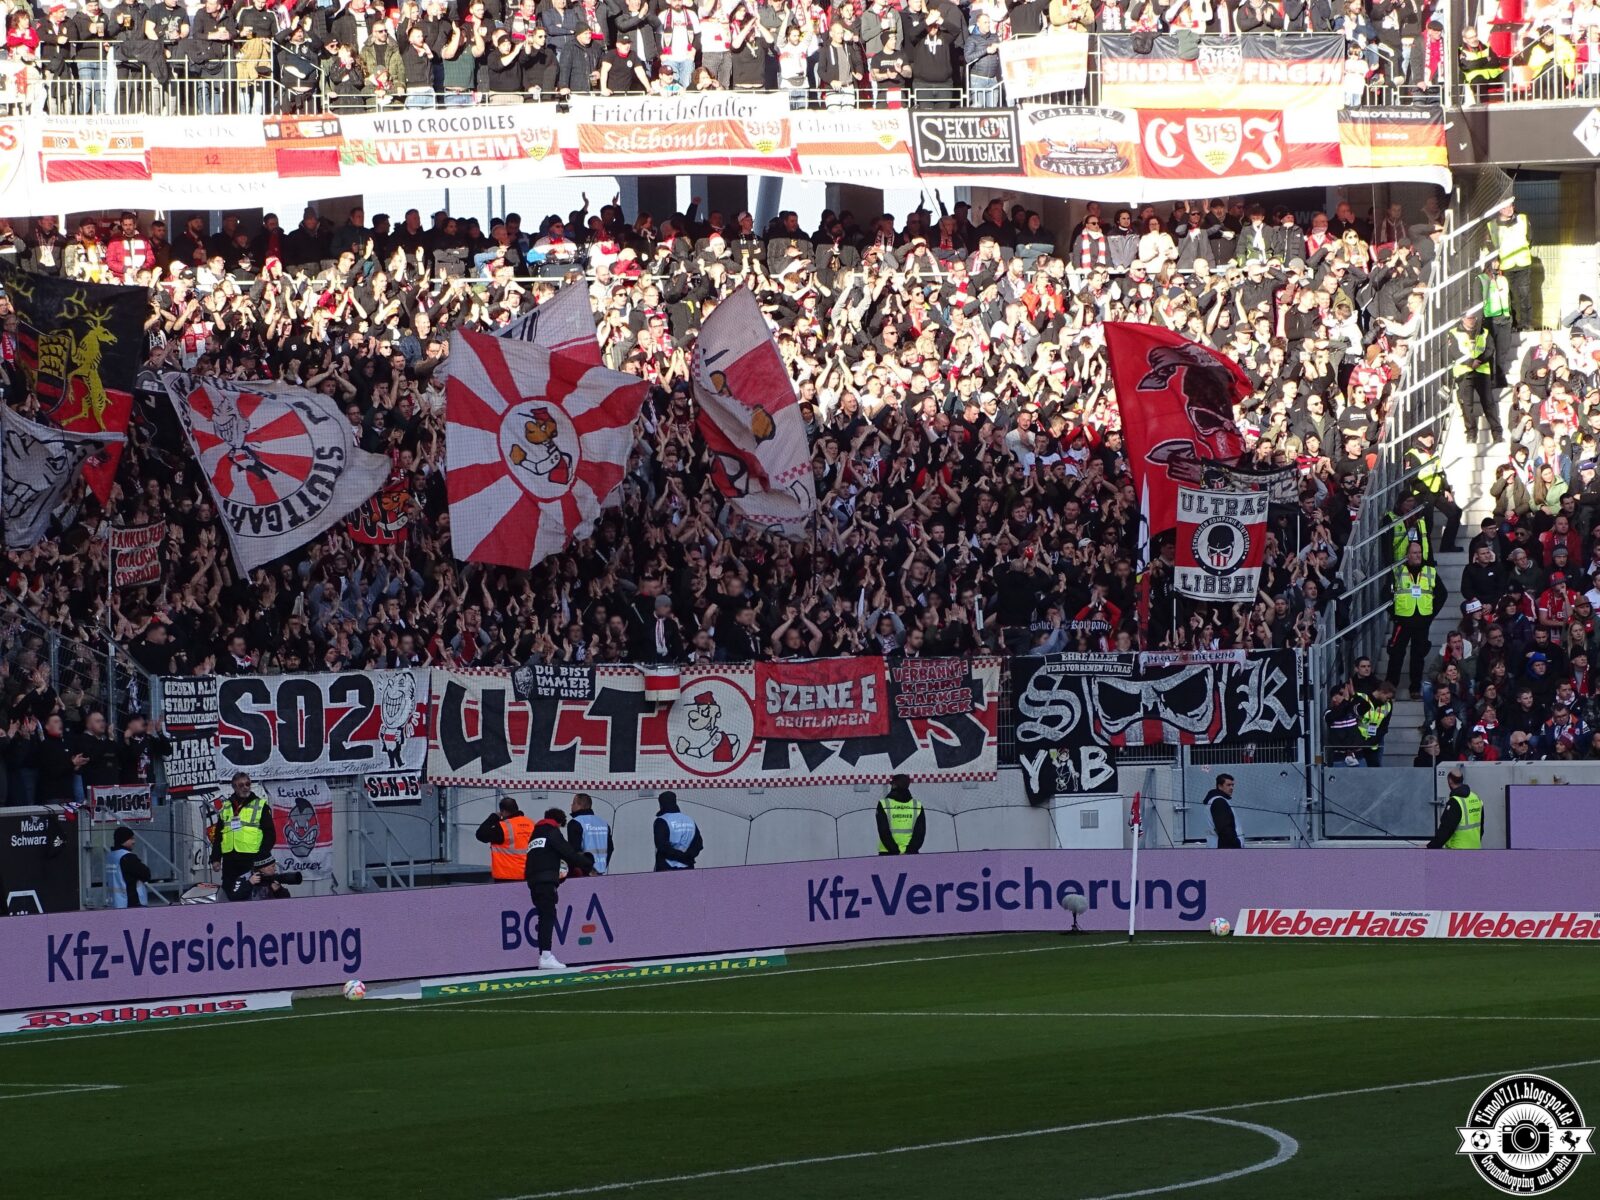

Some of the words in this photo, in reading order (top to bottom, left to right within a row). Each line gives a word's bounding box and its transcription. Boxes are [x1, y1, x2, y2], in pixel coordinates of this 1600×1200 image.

[1105, 63, 1199, 83] SINDEL
[1244, 62, 1342, 83] FINGEN
[592, 95, 758, 122] Friedrichshaller
[1036, 107, 1117, 120] GALEERE
[1350, 110, 1431, 120] BROTHERS
[374, 116, 412, 133] WILD
[418, 115, 515, 132] CROCODILES
[603, 126, 728, 151] Salzbomber
[375, 136, 520, 162] WELZHEIM
[205, 154, 221, 166] 12
[1040, 160, 1123, 176] CANNSTATT
[422, 165, 482, 179] 2004
[1181, 491, 1267, 515] ULTRAS
[117, 547, 158, 567] BRAUCH
[1181, 572, 1254, 594] LIBERI
[1061, 653, 1088, 662] EHRE
[1088, 652, 1118, 662] ALLEN
[534, 664, 555, 676] DU
[560, 666, 590, 678] BIST
[1104, 664, 1132, 674] ULTRAS
[165, 680, 196, 696] GEGEN
[536, 676, 590, 689] IMMER
[901, 677, 962, 694] KEHRT
[537, 687, 556, 697] BEI
[560, 687, 591, 699] UNS!
[765, 676, 853, 715] SZENE
[860, 674, 878, 713] E
[775, 712, 870, 729] REUTLINGEN
[339, 760, 385, 774] Stuttgart
[1080, 745, 1115, 791] B
[167, 770, 217, 787] WIDERSTAN
[365, 775, 398, 799] SLN
[404, 776, 420, 797] 15
[11, 835, 47, 848] Schwarz
[807, 866, 1207, 923] Kfz-Versicherung
[1245, 909, 1429, 937] WeberHaus
[48, 921, 361, 983] Kfz-Versicherung
[438, 956, 772, 996] Schwarzwaldmilch
[18, 998, 248, 1029] Rothaus
